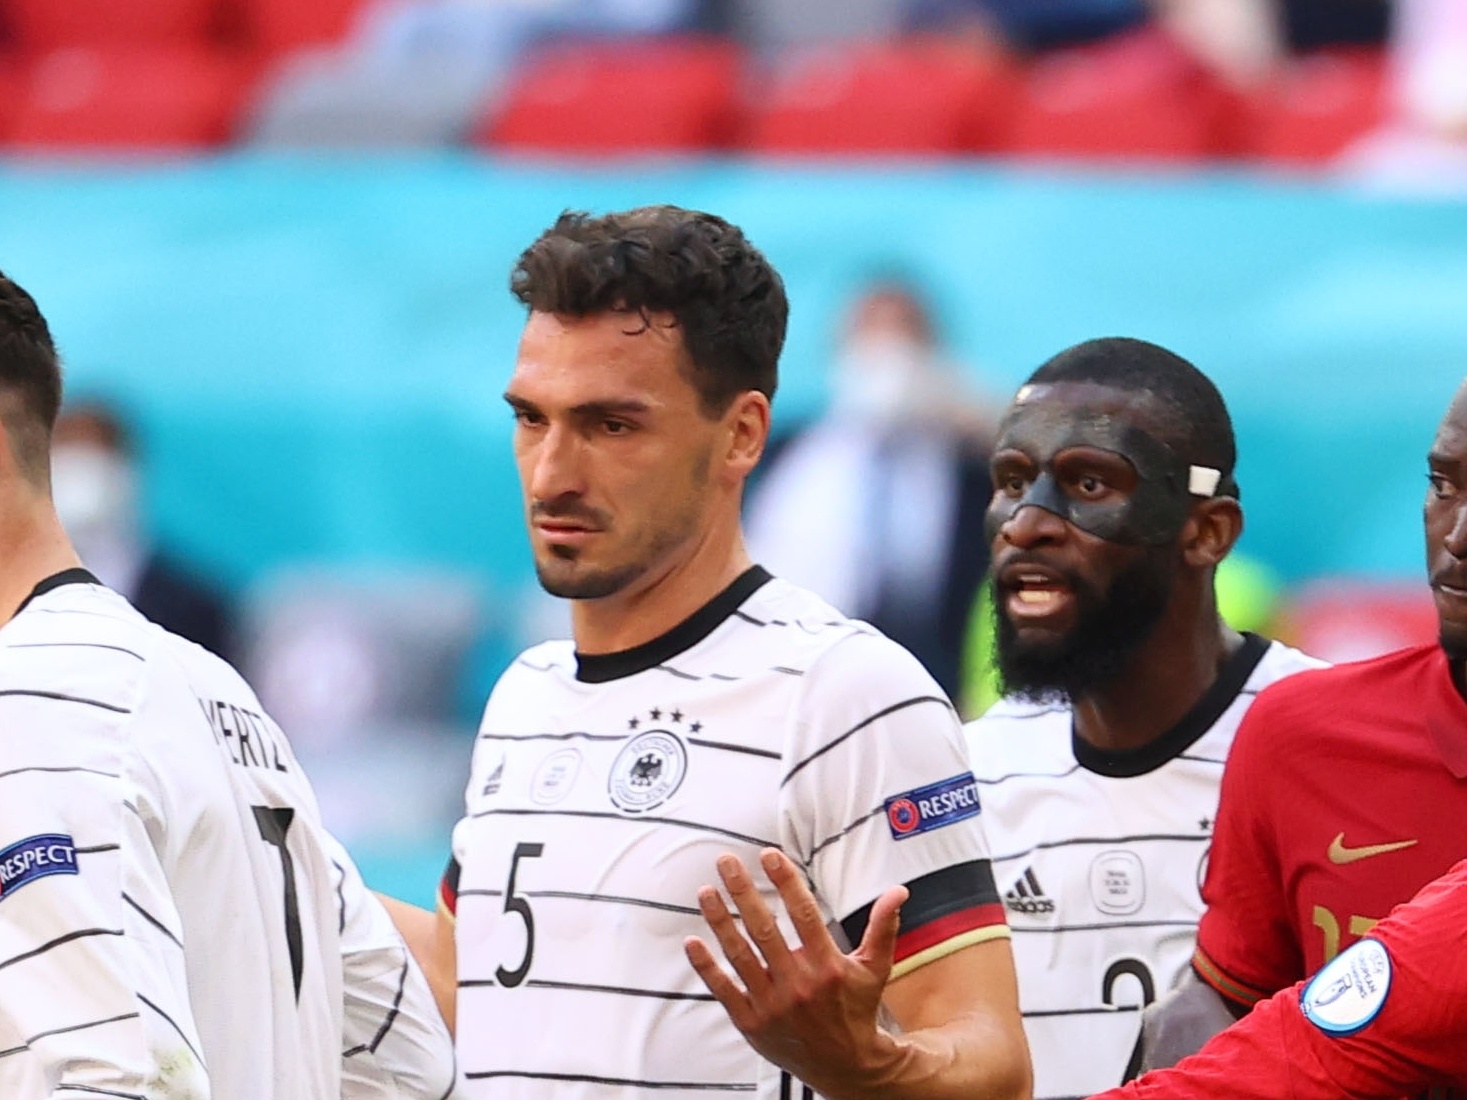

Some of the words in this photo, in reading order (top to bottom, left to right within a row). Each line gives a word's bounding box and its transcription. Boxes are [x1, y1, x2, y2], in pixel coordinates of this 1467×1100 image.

[918, 783, 978, 819] RESPECT
[0, 845, 75, 885] RESPECT
[250, 805, 304, 1008] 7
[494, 842, 545, 989] 5
